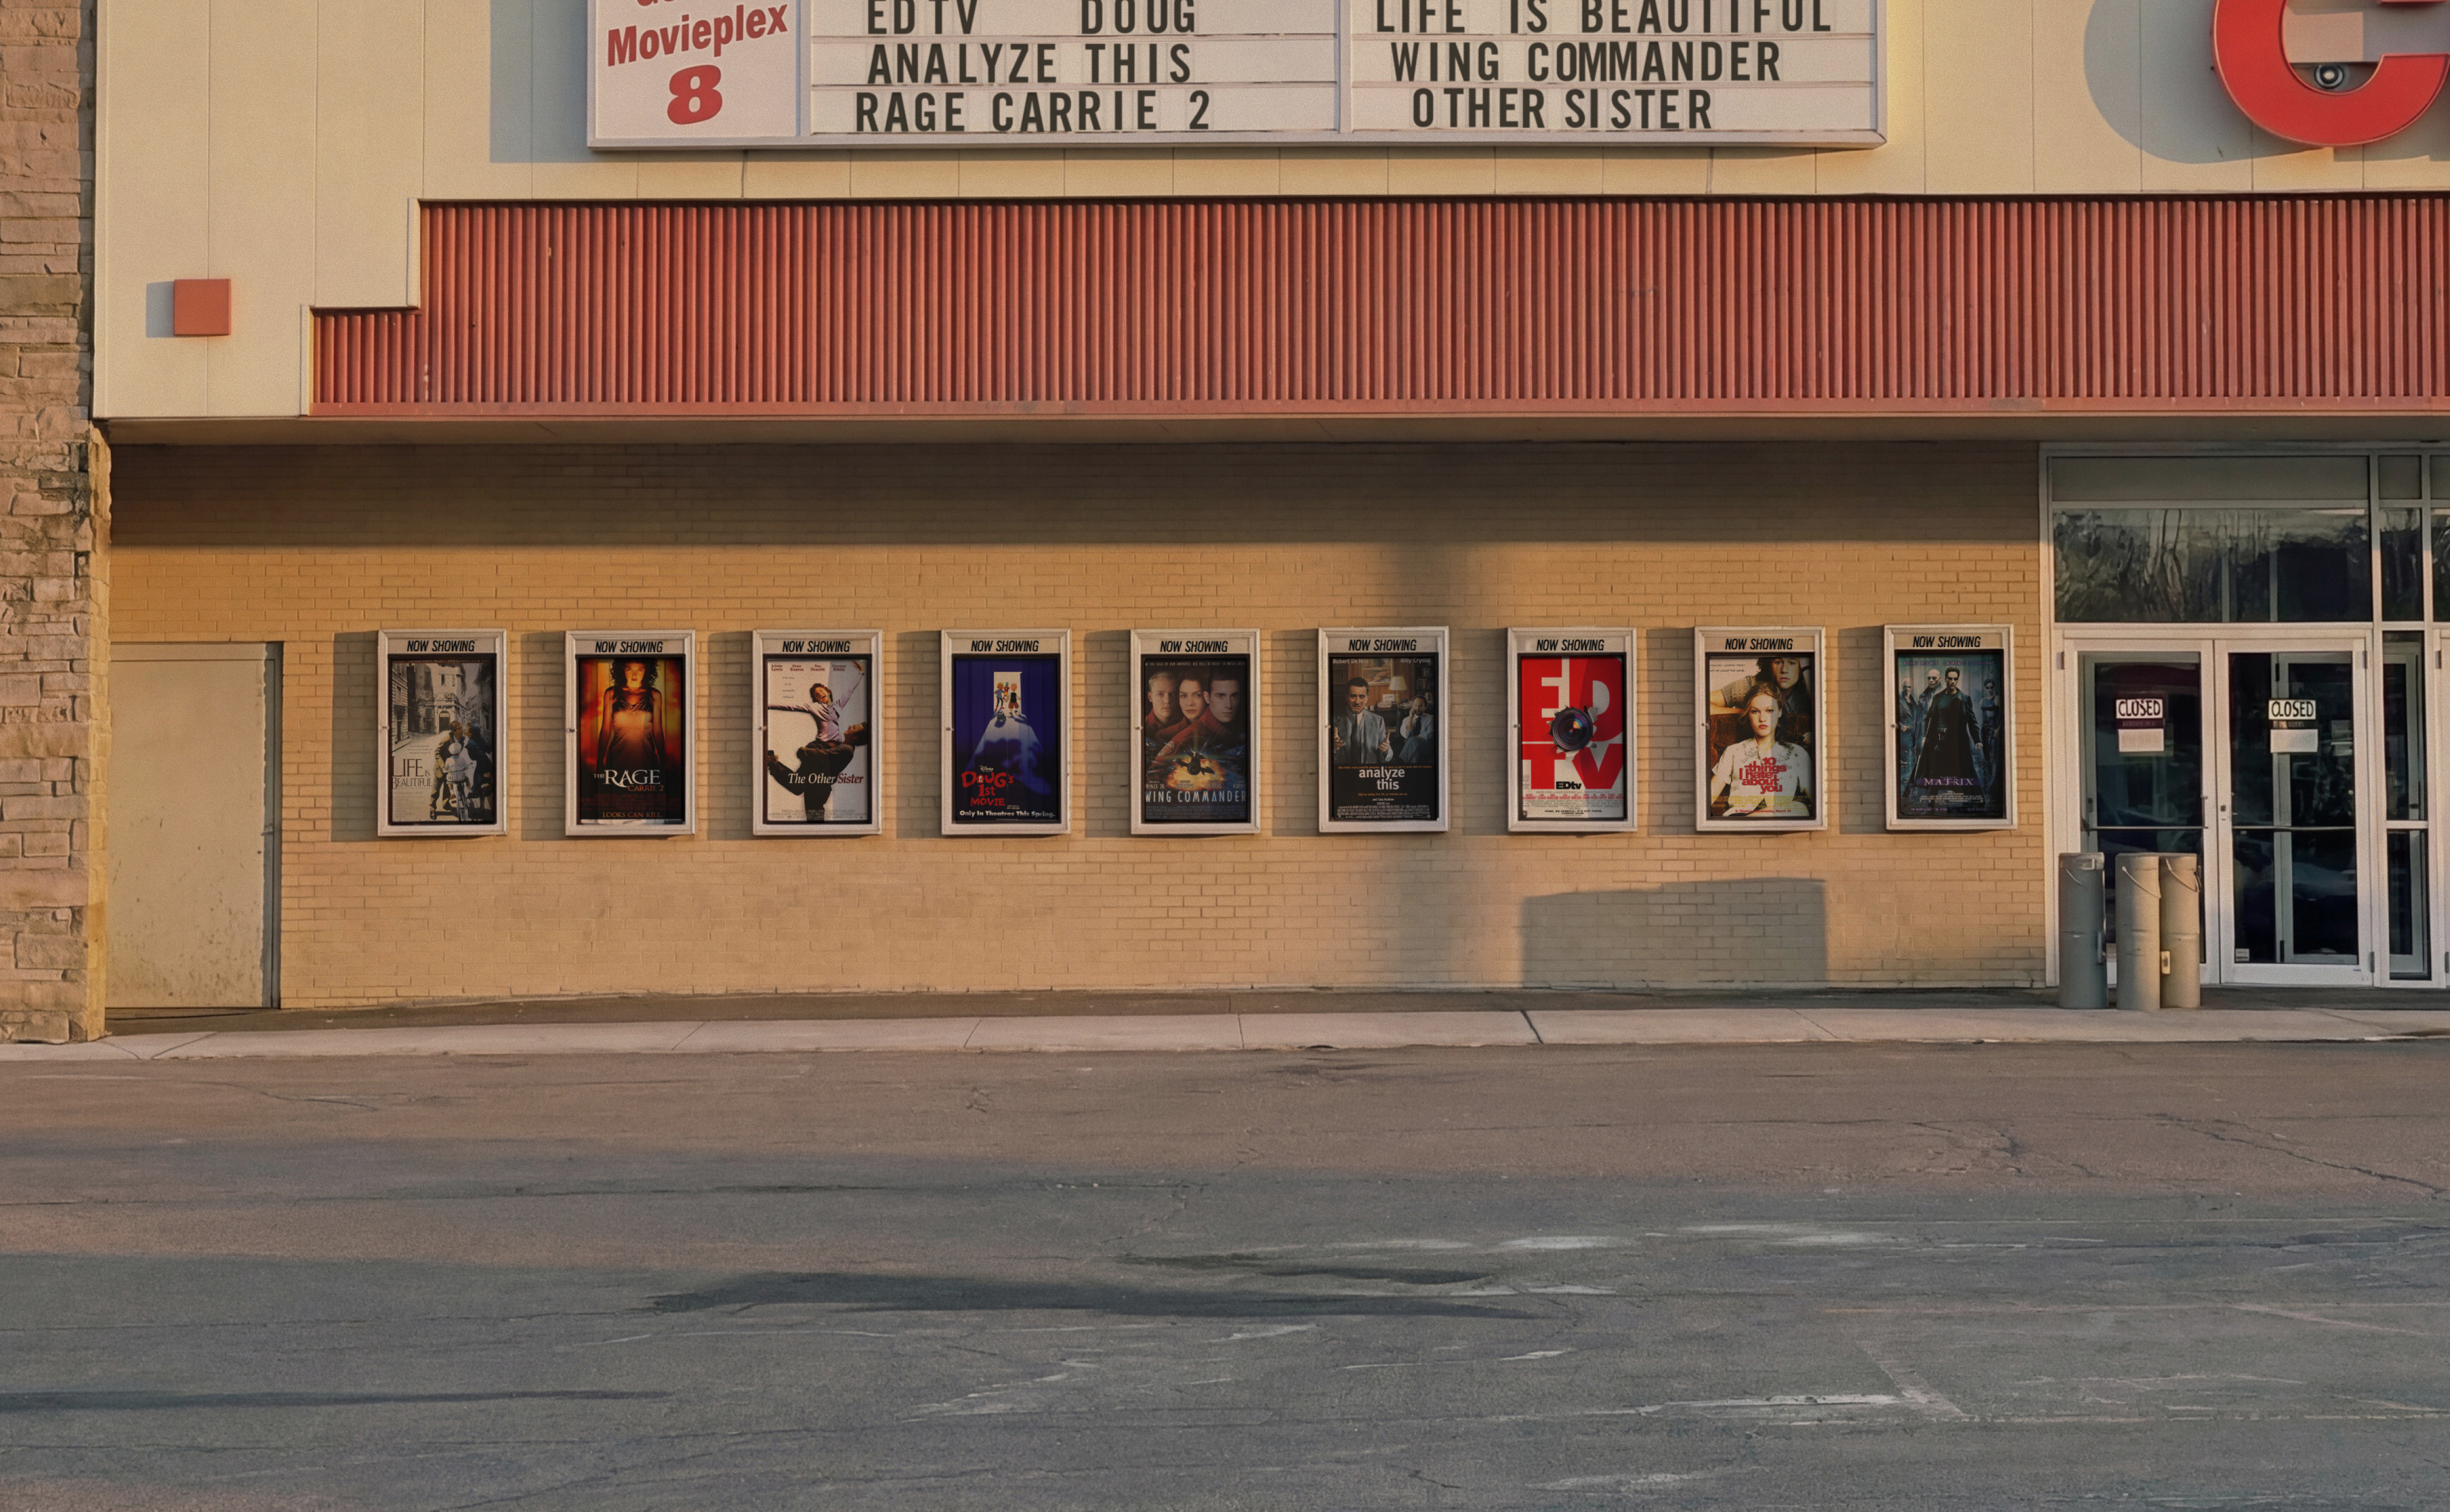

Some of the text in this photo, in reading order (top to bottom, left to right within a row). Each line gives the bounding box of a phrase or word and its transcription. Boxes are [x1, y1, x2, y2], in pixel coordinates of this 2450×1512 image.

[868, 0, 1194, 34] EDTV DOUG
[1377, 0, 1830, 33] LIFE IS BEAUTIFUL
[608, 4, 788, 67] Movieplex
[867, 43, 1190, 84] ANALYZE THIS
[1391, 41, 1780, 81] WING COMMANDER
[667, 64, 723, 125] 8
[856, 90, 1209, 132] RAGE CARRIE 2
[1413, 88, 1711, 129] OTHER SISTER
[407, 640, 474, 652] NOW SHOWING
[595, 641, 663, 653] NOW SHOWING
[782, 641, 850, 652] NOW SHOWING
[971, 640, 1039, 652] NOW SHOWING
[1161, 641, 1228, 652] NOW SHOWING
[1349, 640, 1416, 651] NOW SHOWING
[1537, 640, 1604, 651] NOW SHOWING
[1725, 638, 1793, 650] NOW SHOWING
[1913, 636, 1980, 647] NOW SHOWING
[2118, 700, 2161, 717] CLOSED
[2272, 701, 2313, 717] CLOSED
[392, 756, 423, 777] LIFE
[1744, 760, 1787, 774] things
[1762, 757, 1776, 765] 10
[603, 769, 660, 787] RAGE
[788, 773, 864, 784] The Other Sister
[1359, 766, 1405, 781] analyze
[1740, 768, 1773, 780] I hate
[392, 777, 433, 789] BEAUTIFUL
[1377, 778, 1399, 790] this
[1556, 781, 1582, 790] EDtv
[1742, 775, 1779, 786] about
[1924, 777, 1974, 786] MATRIX
[978, 784, 996, 797] 1st
[1761, 785, 1783, 794] you
[970, 797, 1006, 807] MOVIE
[1145, 791, 1246, 802] WING COMMANDER
